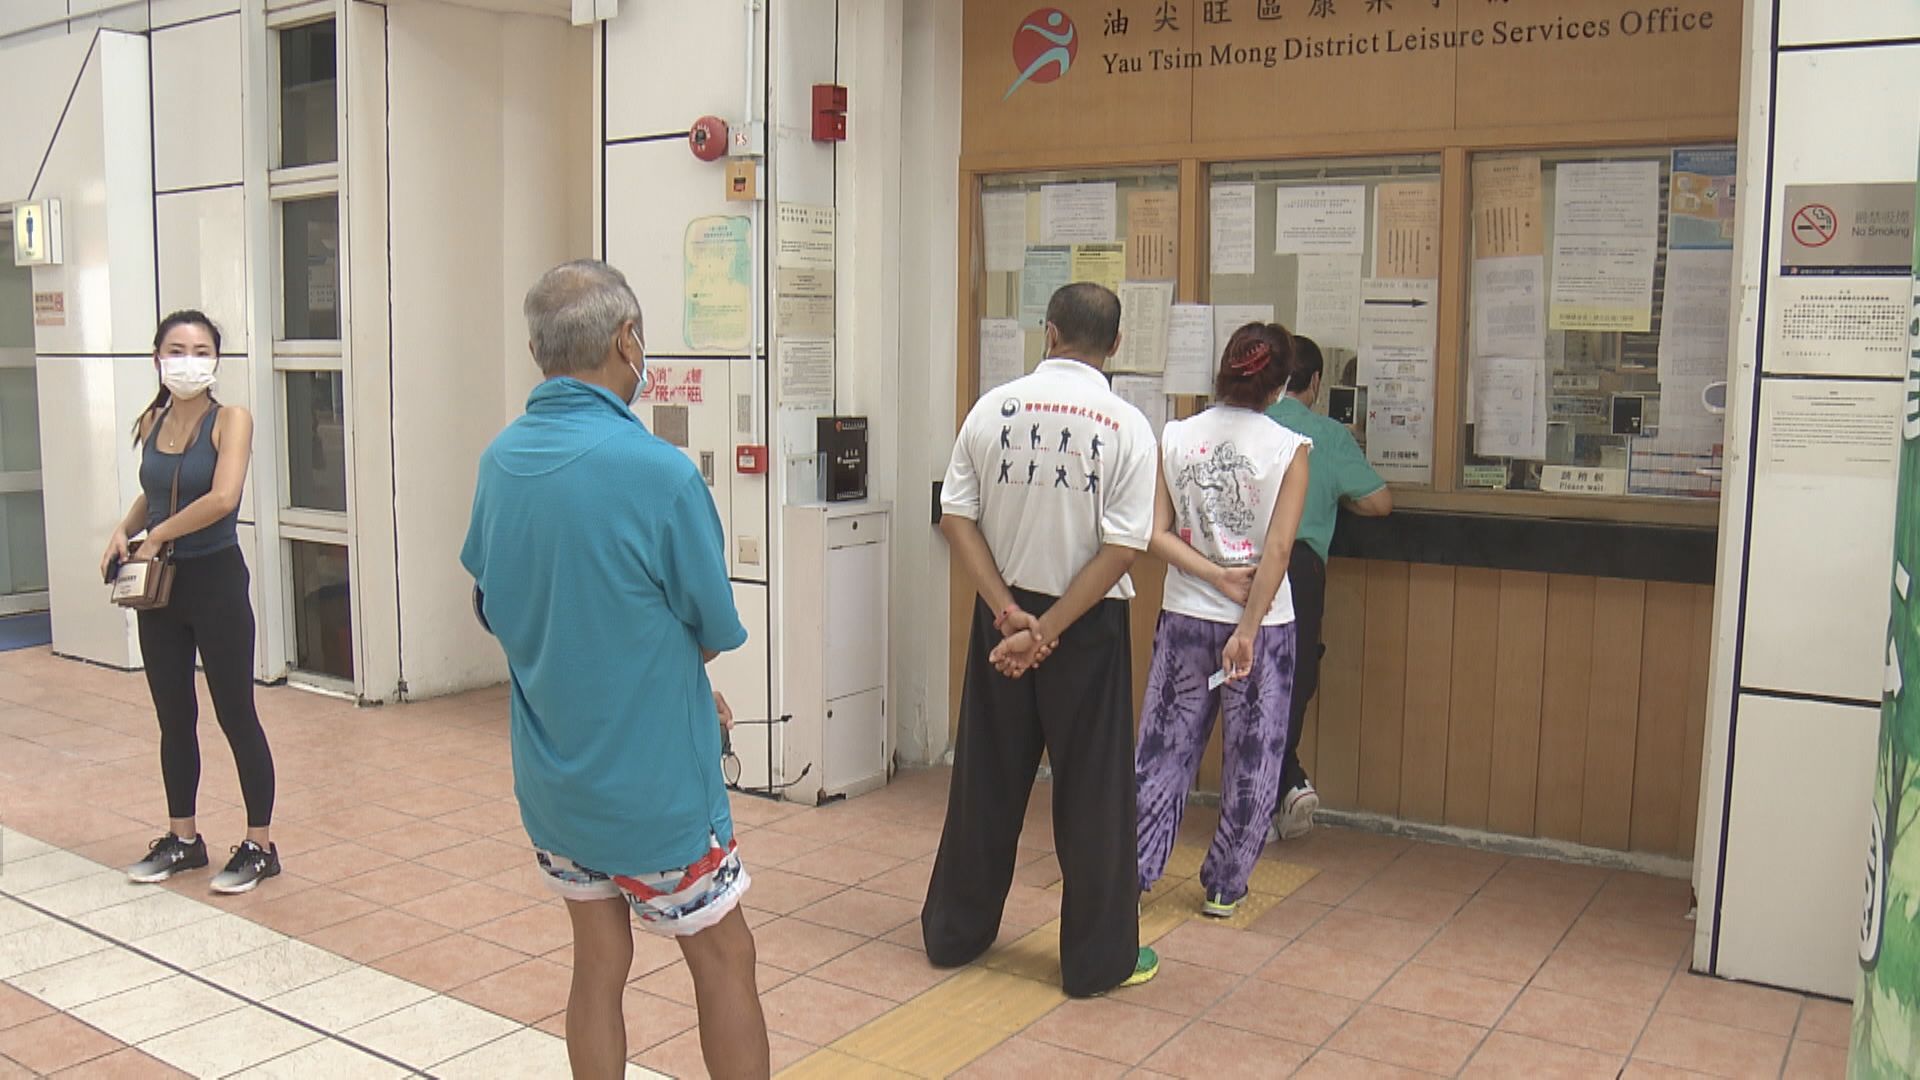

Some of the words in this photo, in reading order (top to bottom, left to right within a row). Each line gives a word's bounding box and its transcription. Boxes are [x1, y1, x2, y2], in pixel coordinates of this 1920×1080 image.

[1102, 53, 1142, 75] Yau
[1149, 47, 1203, 72] Tsim
[1210, 43, 1278, 69] Mong
[1284, 32, 1379, 61] District
[1386, 26, 1484, 53] Leisure
[1492, 15, 1610, 45] Services
[1620, 6, 1714, 36] Office
[1851, 226, 1866, 237] No
[1868, 225, 1910, 239] Smoking
[656, 385, 669, 402] FIRE
[687, 385, 703, 402] REEL
[1560, 481, 1585, 491] Please
[1587, 483, 1604, 492] wait
